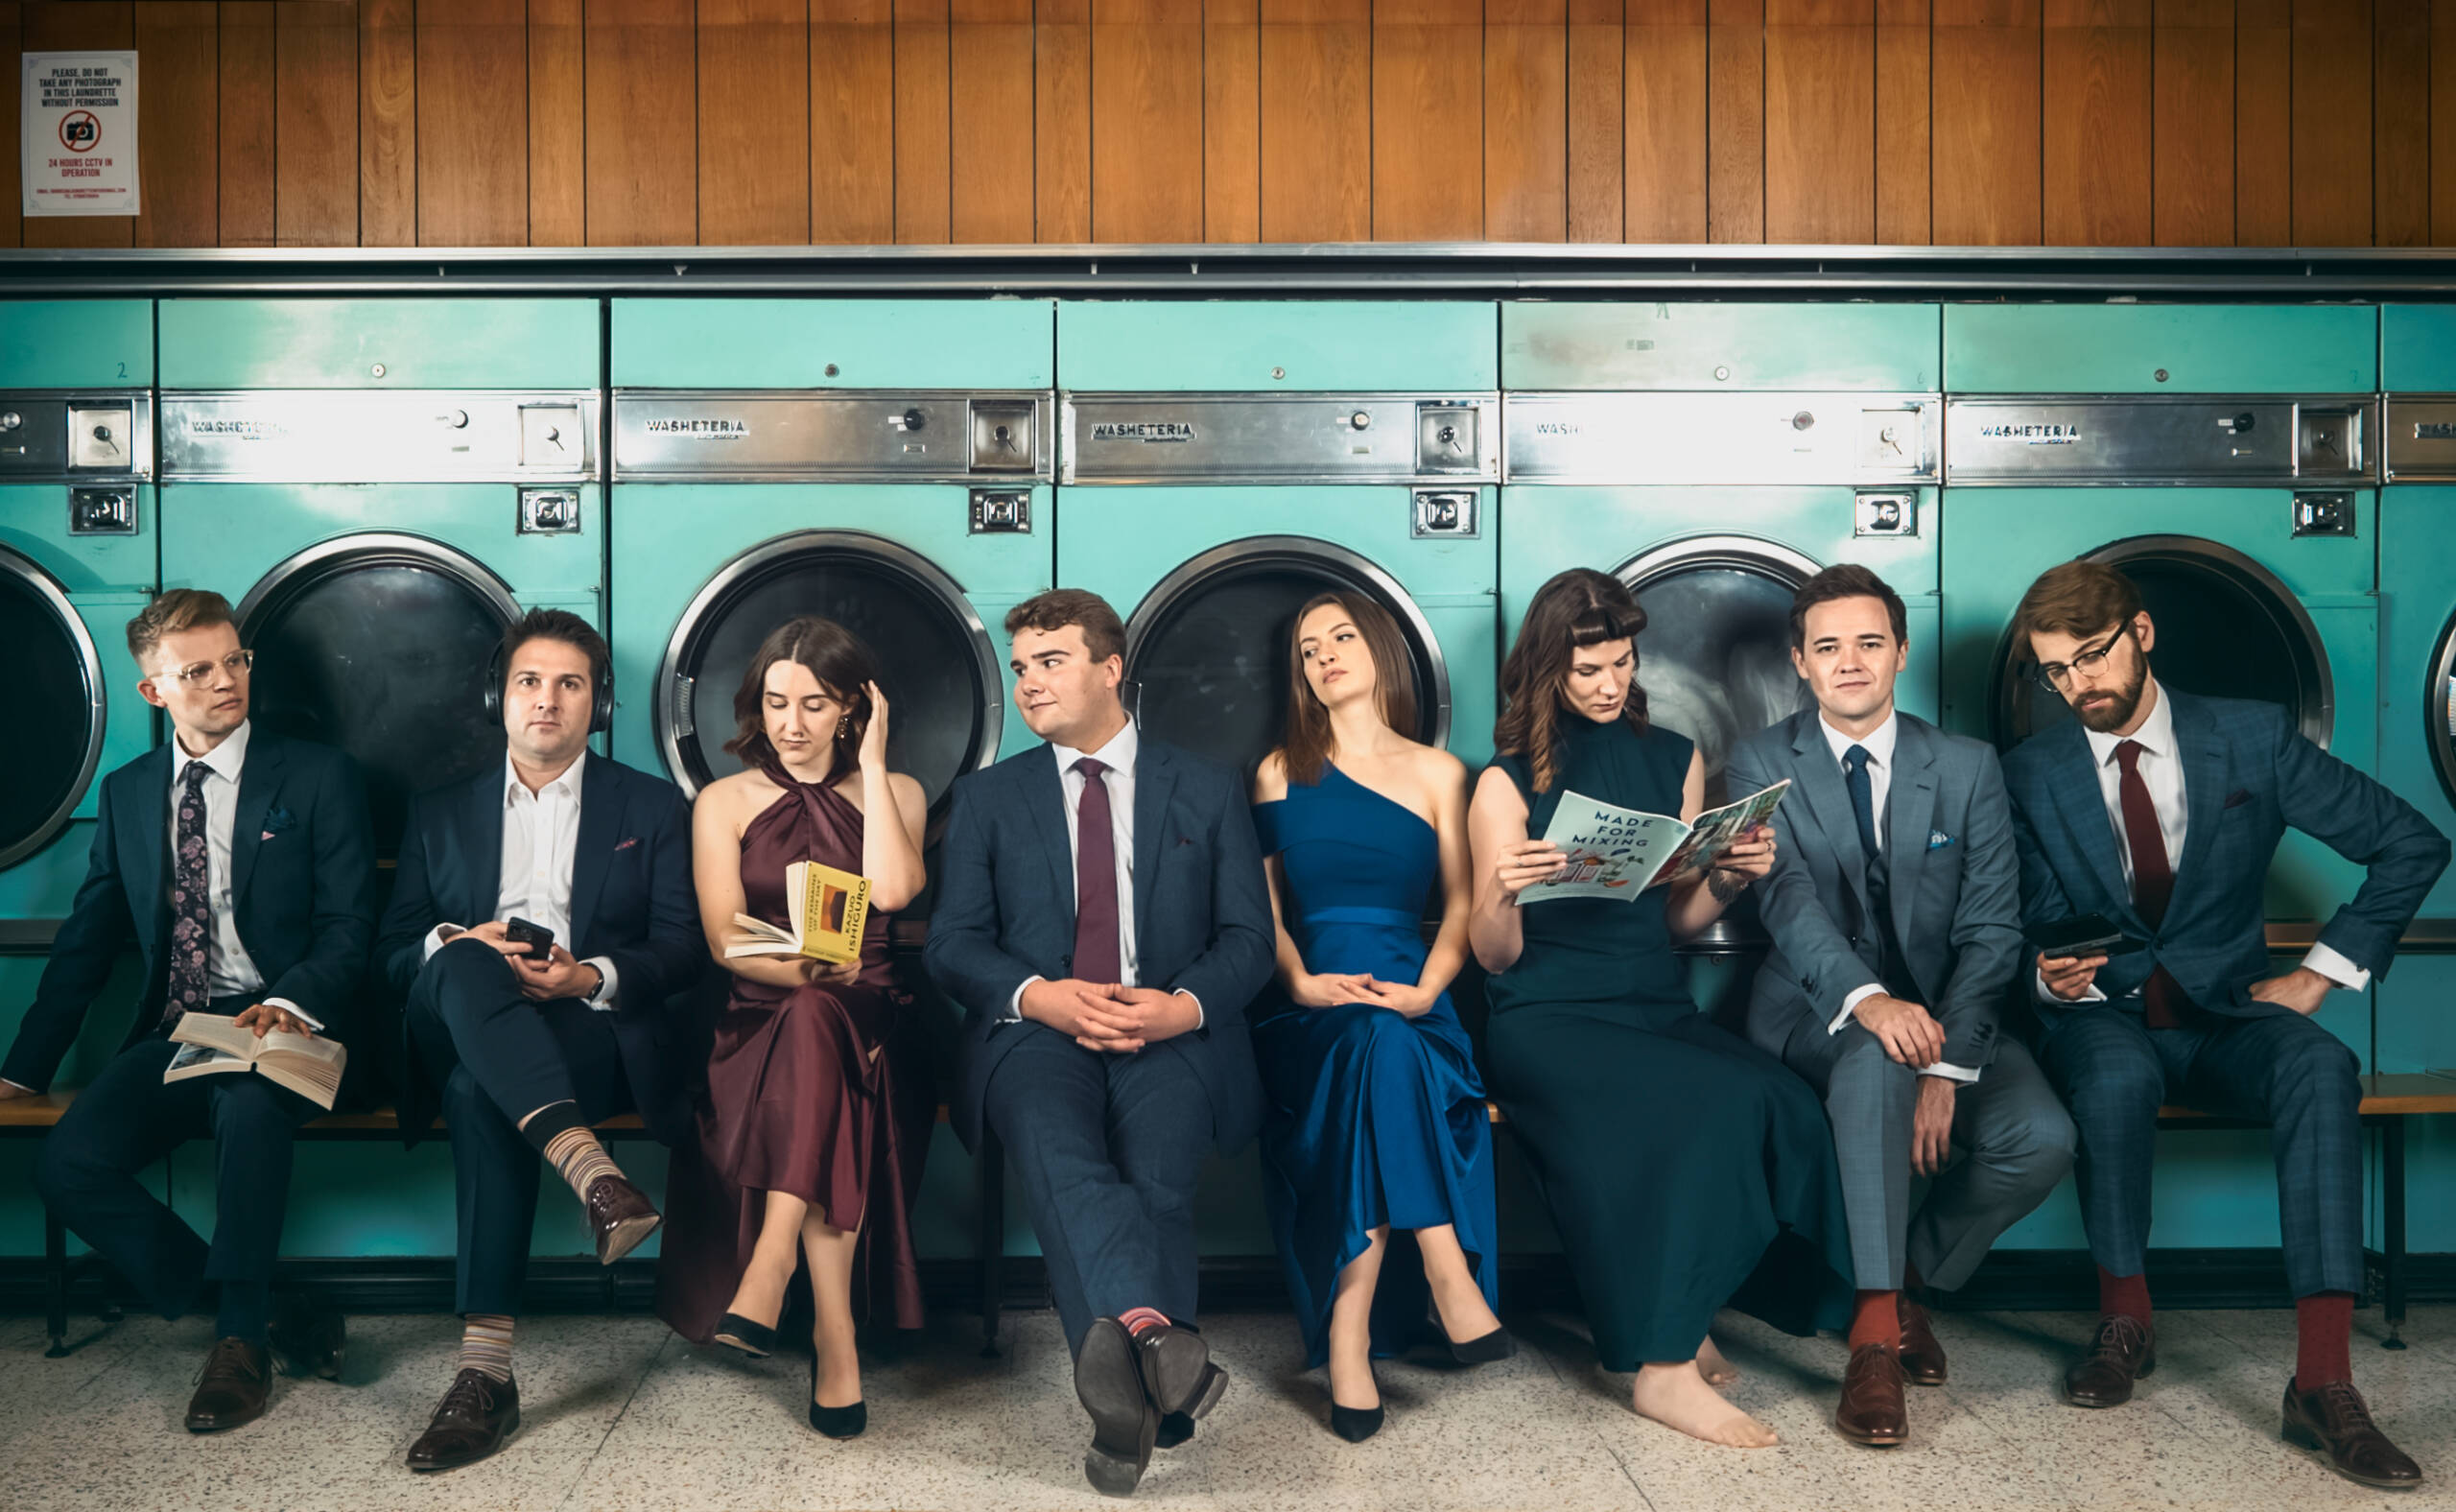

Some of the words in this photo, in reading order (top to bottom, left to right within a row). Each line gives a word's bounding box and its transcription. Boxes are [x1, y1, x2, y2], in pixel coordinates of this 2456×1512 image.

[83, 68, 92, 77] DO
[94, 68, 107, 77] NOT
[39, 79, 56, 87] TAKE
[75, 78, 121, 86] PHOTOGRAPH
[54, 88, 69, 97] THIS
[72, 88, 116, 97] LAUNDRETTE
[41, 99, 73, 107] WITHOUT
[75, 98, 119, 106] PERMISSION
[48, 158, 58, 168] 24
[59, 158, 83, 167] HOURS
[84, 157, 103, 167] CCTV
[105, 158, 112, 167] IN
[61, 168, 101, 177] OPERATION
[646, 420, 744, 432] WASHETERIA
[1093, 423, 1192, 436] WASHETERIA
[1980, 425, 2077, 437] WASHETERIA
[1594, 811, 1653, 827] MADE
[1596, 825, 1637, 837] FOR
[1572, 834, 1649, 847] MIXING
[845, 894, 856, 934] KAZUO
[848, 881, 866, 952] ISHIGURO
